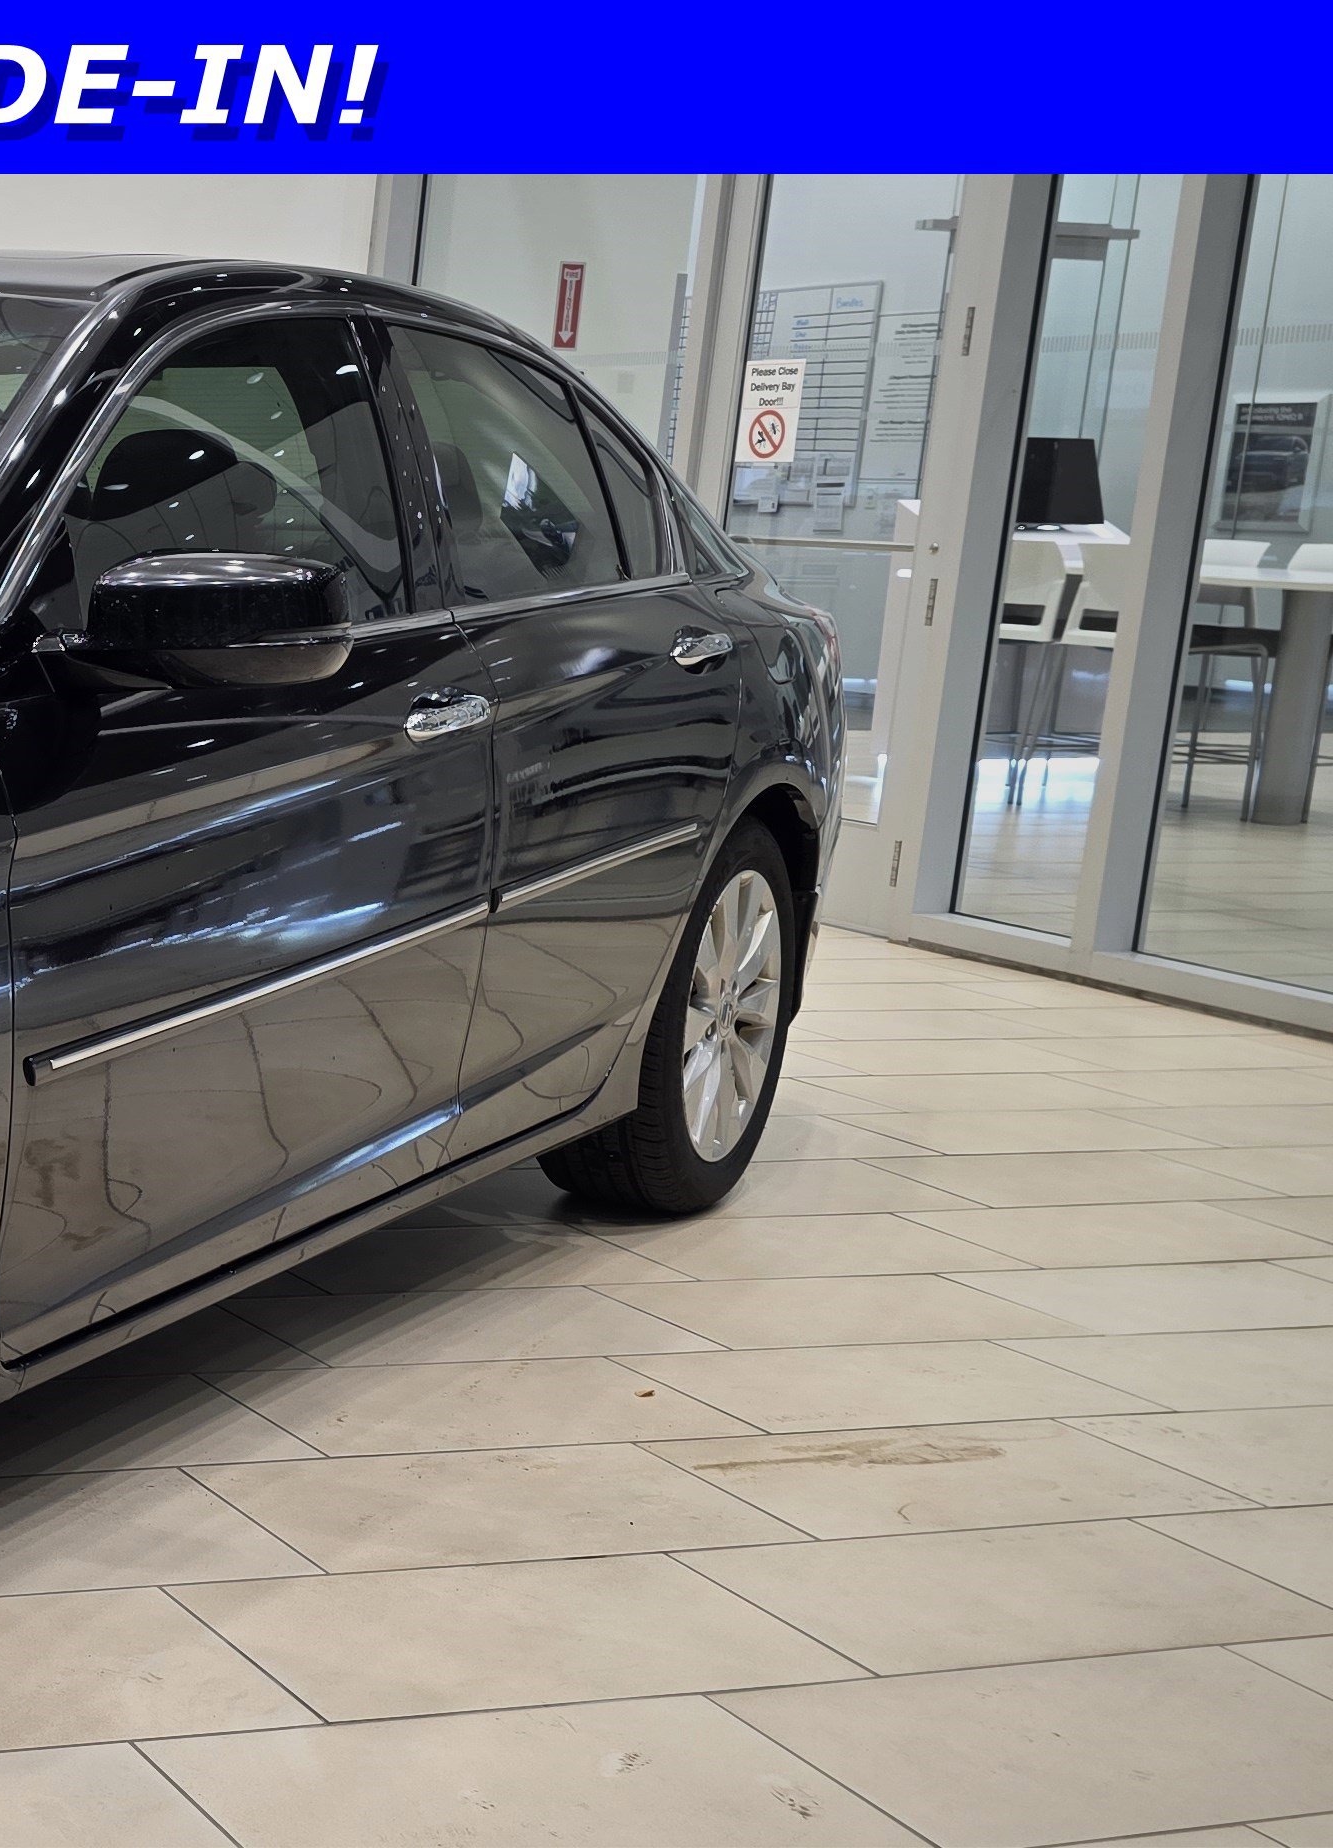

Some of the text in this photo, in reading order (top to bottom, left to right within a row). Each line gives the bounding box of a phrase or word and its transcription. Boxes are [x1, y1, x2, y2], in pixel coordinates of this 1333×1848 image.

[751, 366, 798, 376] Please Close
[750, 381, 795, 392] Delivery Bay
